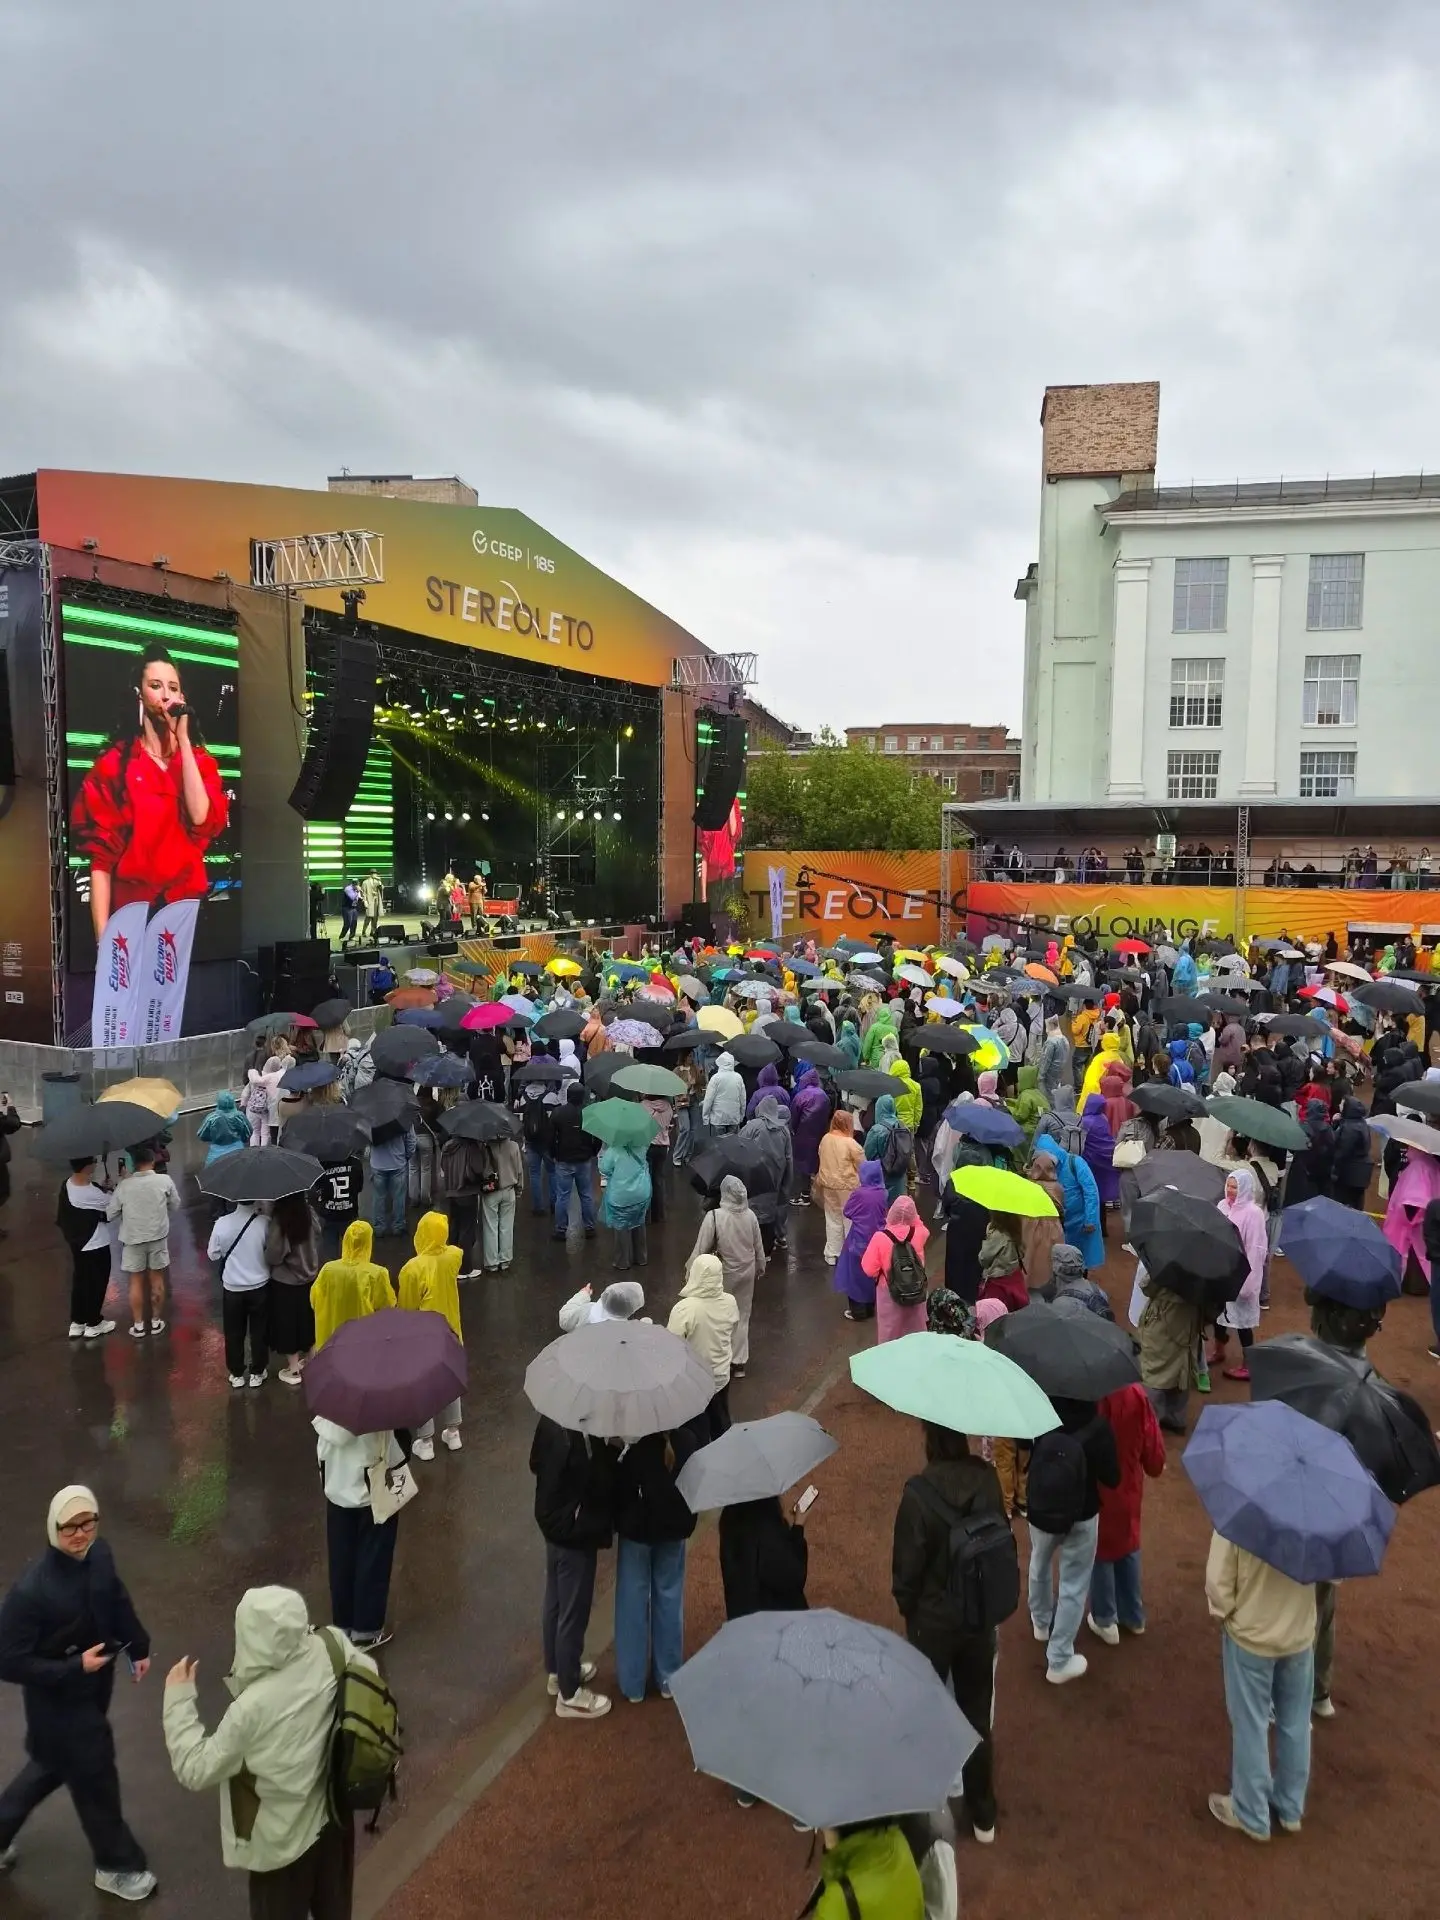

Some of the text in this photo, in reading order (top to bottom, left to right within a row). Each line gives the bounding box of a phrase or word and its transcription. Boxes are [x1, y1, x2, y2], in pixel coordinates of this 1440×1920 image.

[490, 540, 555, 574] СБЕР 185
[425, 575, 594, 651] STEREOLETO
[329, 1176, 349, 1199] 12
